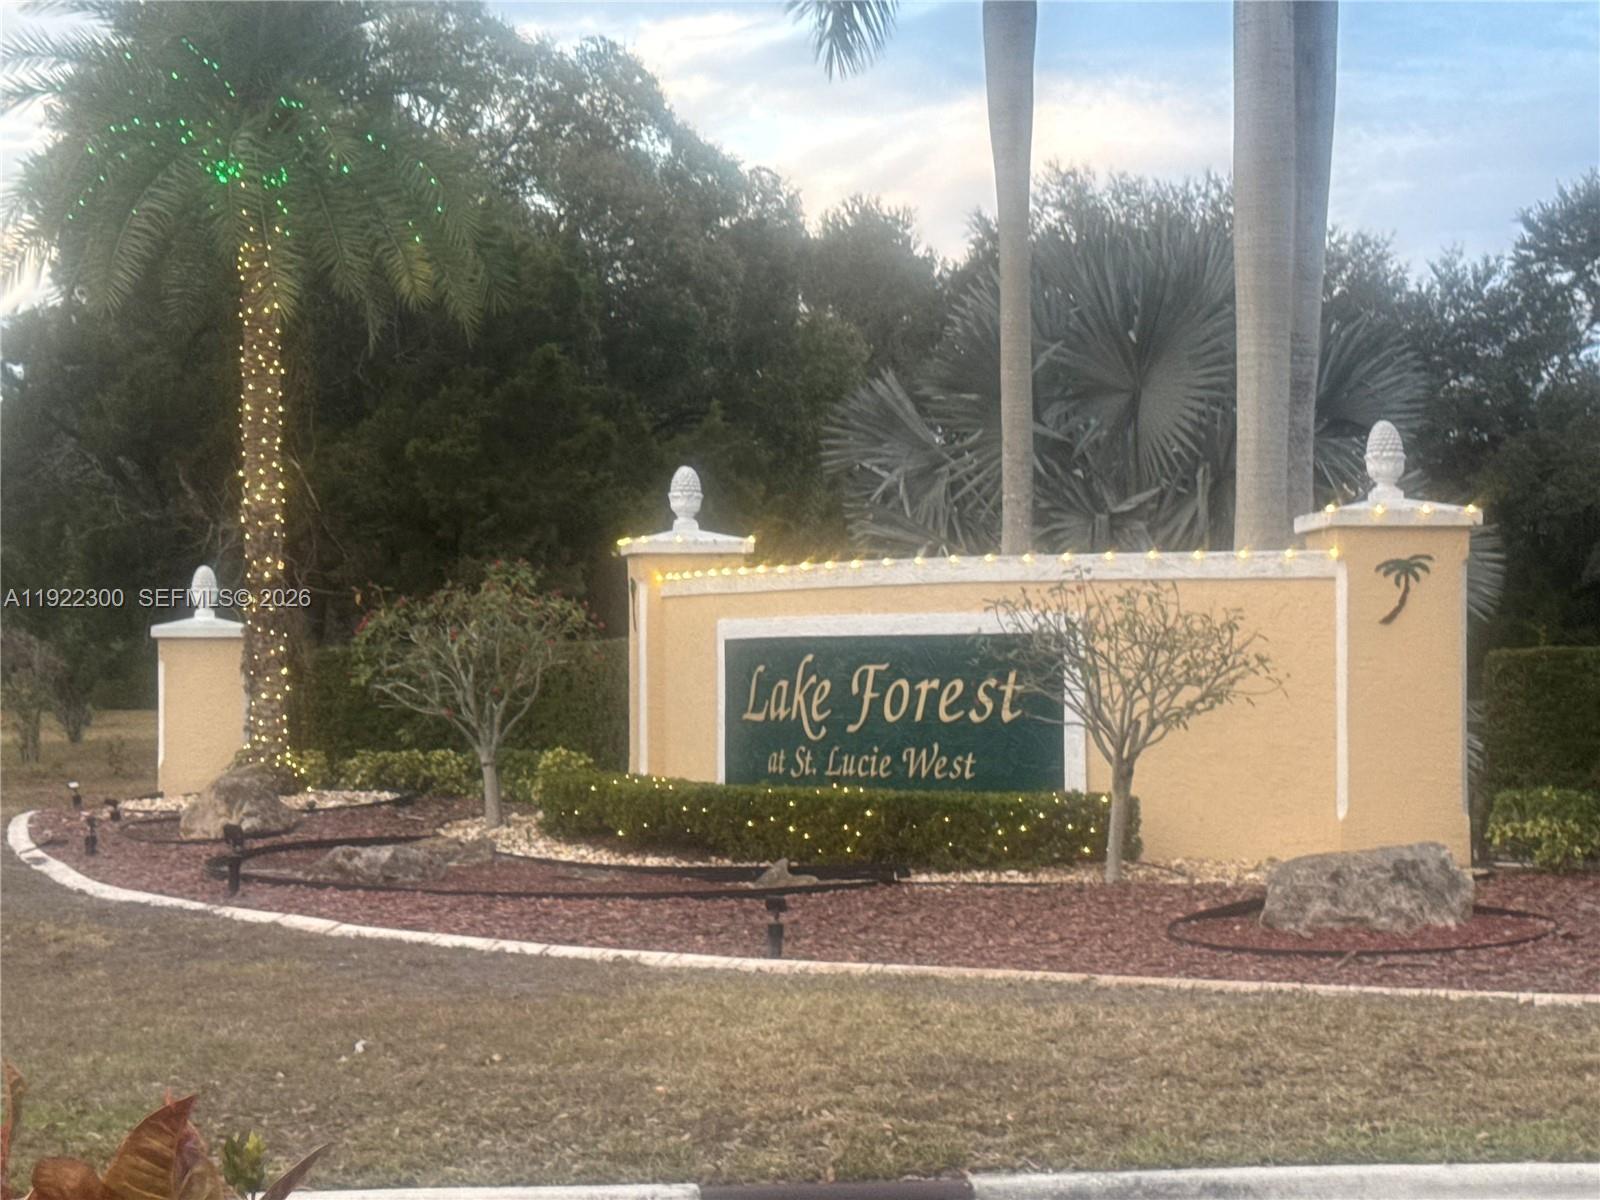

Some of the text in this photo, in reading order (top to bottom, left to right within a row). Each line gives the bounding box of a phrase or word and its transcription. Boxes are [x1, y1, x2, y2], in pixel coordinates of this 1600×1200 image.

[742, 654, 1025, 741] Lake Forest
[768, 742, 977, 780] at St. Lucie West
